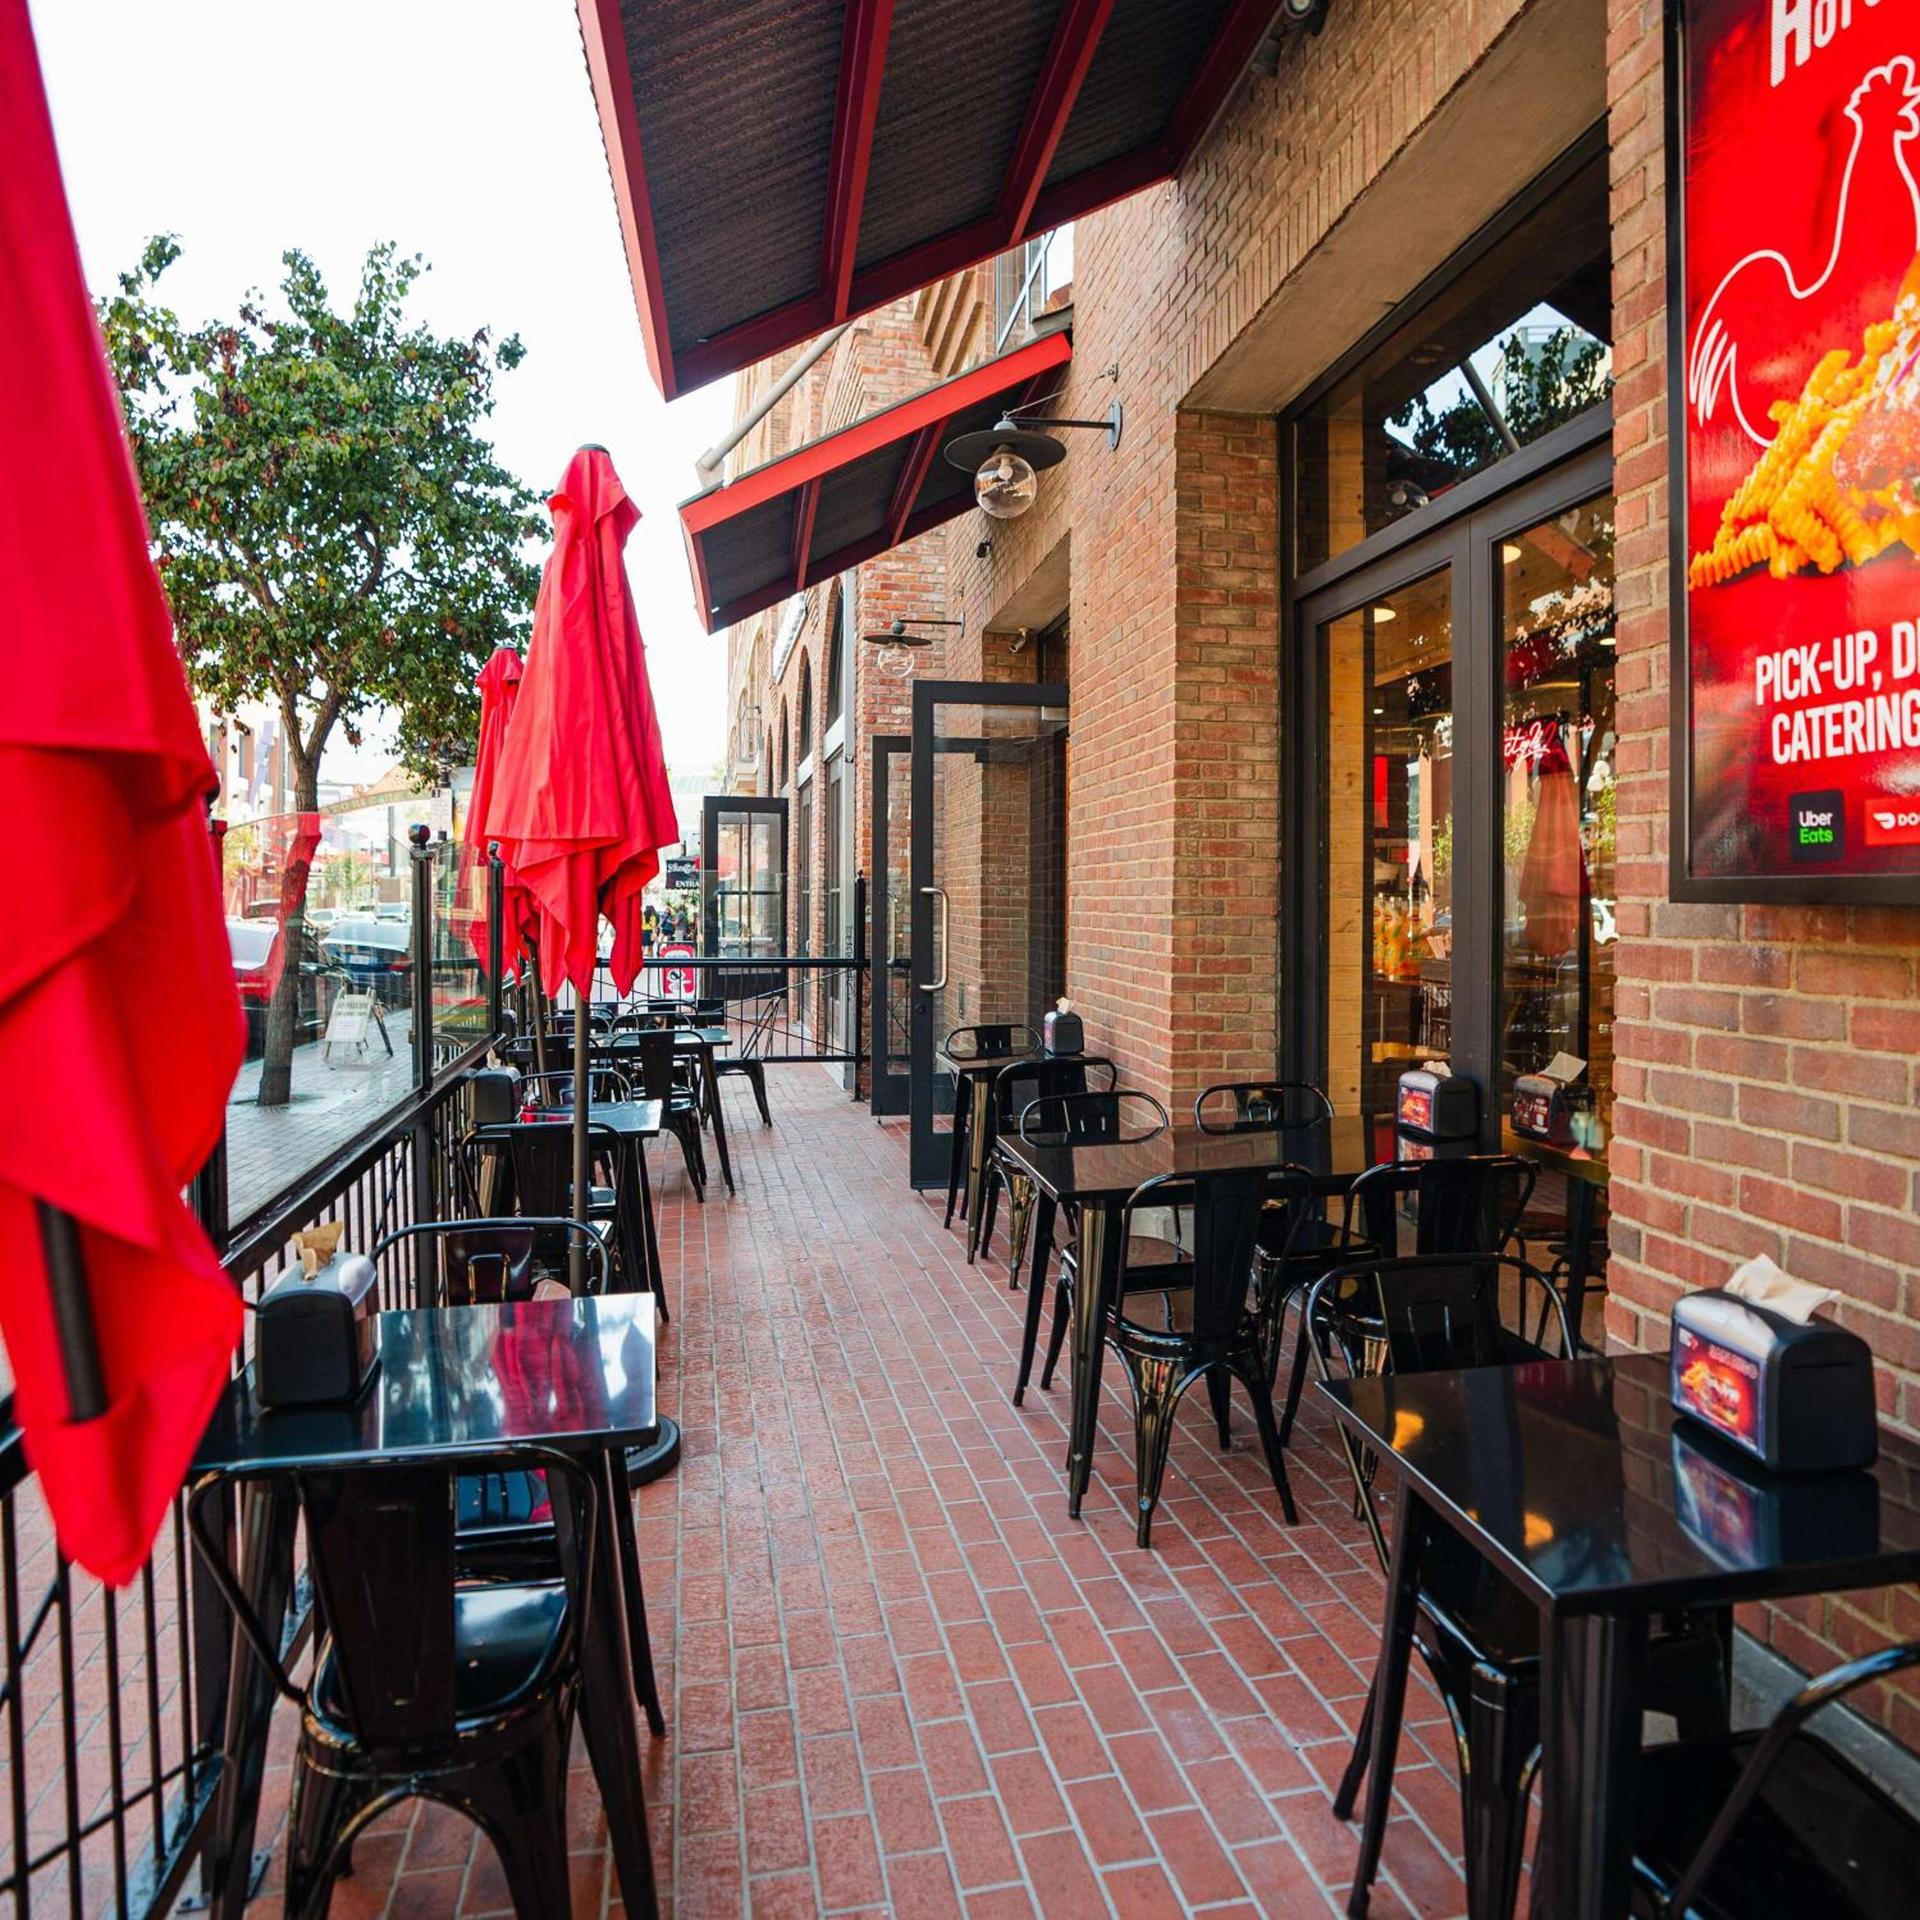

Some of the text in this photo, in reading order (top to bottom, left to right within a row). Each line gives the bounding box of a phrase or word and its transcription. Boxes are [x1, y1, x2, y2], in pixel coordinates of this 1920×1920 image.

[1755, 617, 1920, 706] PICK-UP, D
[1771, 688, 1920, 765] CATERING
[1799, 811, 1833, 827] Uber
[1897, 812, 1920, 827] DO
[1799, 828, 1834, 844] Eats
